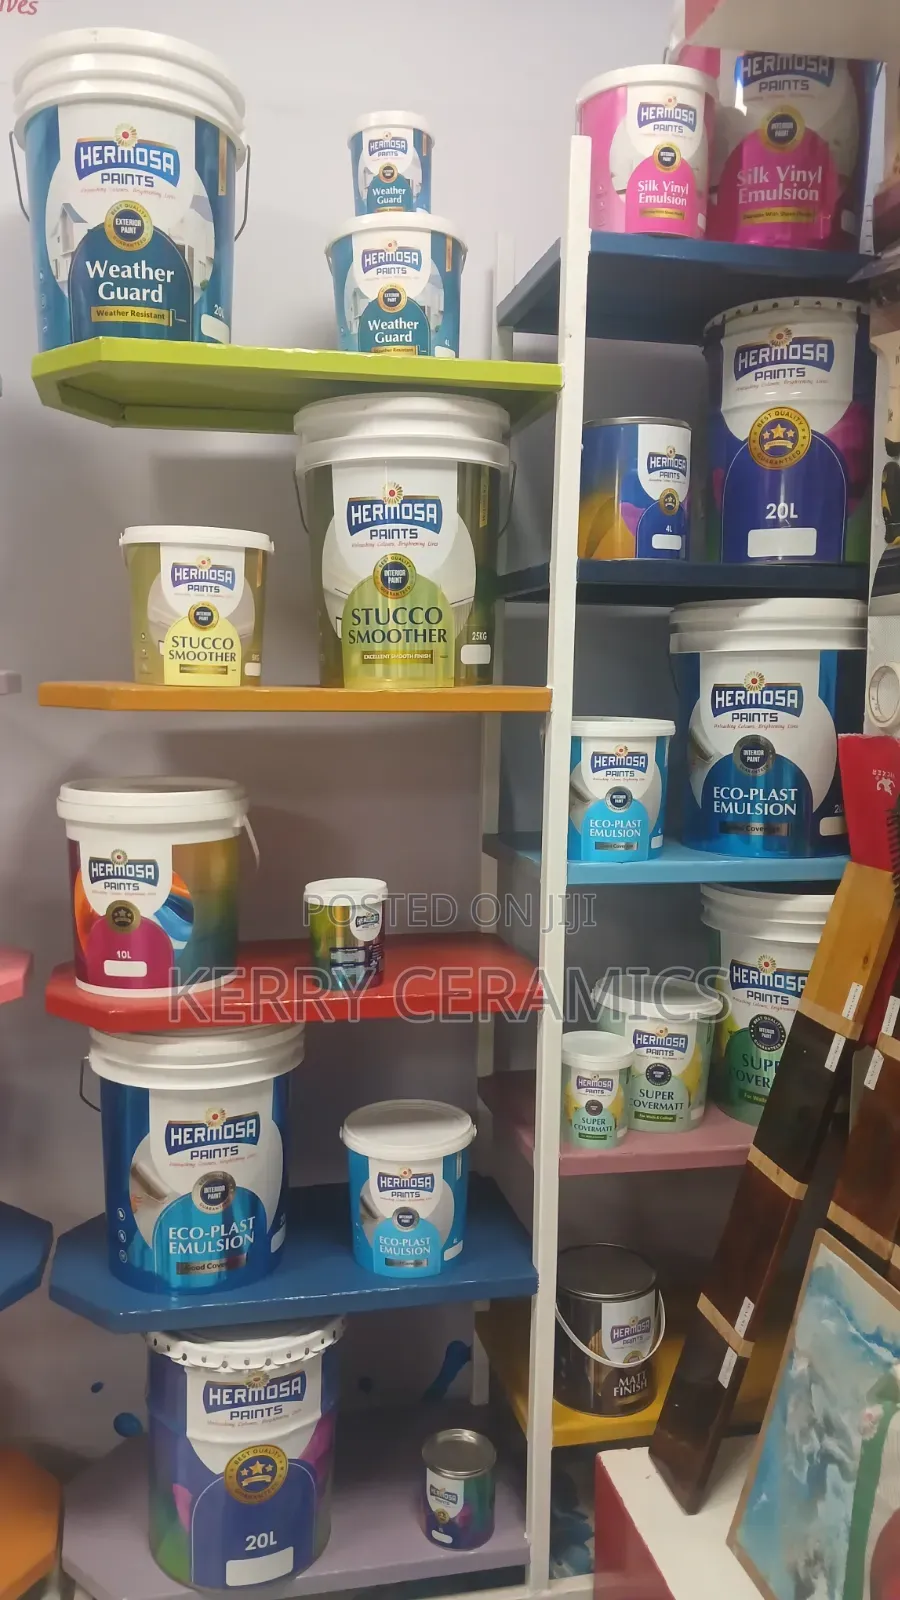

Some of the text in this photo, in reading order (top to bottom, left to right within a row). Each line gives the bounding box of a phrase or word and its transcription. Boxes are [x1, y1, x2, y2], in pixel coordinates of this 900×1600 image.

[741, 54, 829, 76] HERMOSA
[759, 80, 809, 93] PAINTS
[641, 107, 696, 125] HERMOSA
[653, 125, 684, 134] PAINTS
[369, 140, 406, 152] HERMOSA
[79, 146, 175, 176] HERMOSA
[101, 172, 154, 188] PAINTS
[737, 165, 822, 188] Silk Vinyl
[372, 185, 407, 196] Weather
[638, 180, 689, 197] Silk Vinyl
[738, 183, 819, 205] Emulsion
[376, 194, 402, 205] Guard
[638, 192, 687, 206] Emulsion
[115, 217, 142, 227] EXTERIOR
[120, 226, 137, 235] PAINT
[364, 251, 419, 270] HERMOSA
[85, 259, 175, 283] Weather
[376, 266, 407, 275] PAINTS
[98, 281, 163, 303] Guard
[96, 307, 166, 321] Weather Resistant
[367, 317, 420, 331] Weather
[374, 330, 413, 344] Guard
[738, 344, 828, 372] HERMOSA
[754, 367, 806, 382] PAINTS
[757, 410, 803, 428] BEST QUALITY
[649, 456, 687, 470] HERMOSA
[756, 449, 801, 465] GUARANTEED
[659, 471, 681, 480] PAINTS
[350, 502, 438, 526] HERMOSA
[765, 503, 799, 521] 20L
[369, 528, 419, 540] PAINTS
[665, 525, 673, 533] 4L
[174, 567, 233, 585] HERMOSA
[383, 569, 406, 577] INTERIOR
[387, 576, 403, 584] PAINT
[187, 584, 221, 593] PAINTS
[351, 606, 443, 626] STUCCO
[171, 635, 235, 650] STUCCO
[348, 628, 448, 645] SMOOTHER
[471, 631, 488, 641] 25KG
[168, 649, 237, 663] SMOOTHER
[715, 689, 798, 709] HERMOSA
[731, 712, 779, 723] PAINTS
[594, 755, 646, 768] HERMOSA
[713, 786, 798, 801] ECO-PLAST
[713, 800, 797, 816] EMULSION
[589, 819, 642, 829] ECO-PLAST
[589, 828, 641, 838] EMULSION
[91, 862, 155, 880] HERMOSA
[104, 881, 140, 891] PAINTS
[116, 950, 132, 959] 10L
[746, 990, 790, 1006] PAINTS
[763, 1015, 783, 1029] QUALITY
[635, 1033, 686, 1048] HERMOSA
[645, 1048, 675, 1057] PAINTS
[578, 1079, 612, 1088] HERMOSA
[639, 1088, 674, 1101] SUPER
[581, 1117, 606, 1125] SUPER
[170, 1119, 256, 1147] HERMOSA
[574, 1124, 613, 1133] COVERMATT
[190, 1145, 239, 1160] PAINTS
[203, 1184, 226, 1194] INTERIOR
[380, 1176, 432, 1189] HERMOSA
[168, 1216, 256, 1240] ECO-PLAST
[169, 1232, 255, 1255] EMULSION
[379, 1235, 431, 1247] ECO-PLAST
[379, 1244, 431, 1256] EMULSION
[613, 1319, 650, 1340] HERMOSA
[618, 1370, 647, 1387] MATT
[209, 1376, 301, 1406] HERMOSA
[613, 1379, 648, 1397] FINISH
[229, 1404, 283, 1421] PAINTS
[234, 1447, 281, 1465] BEST QUALITY
[244, 1530, 278, 1551] 20L
